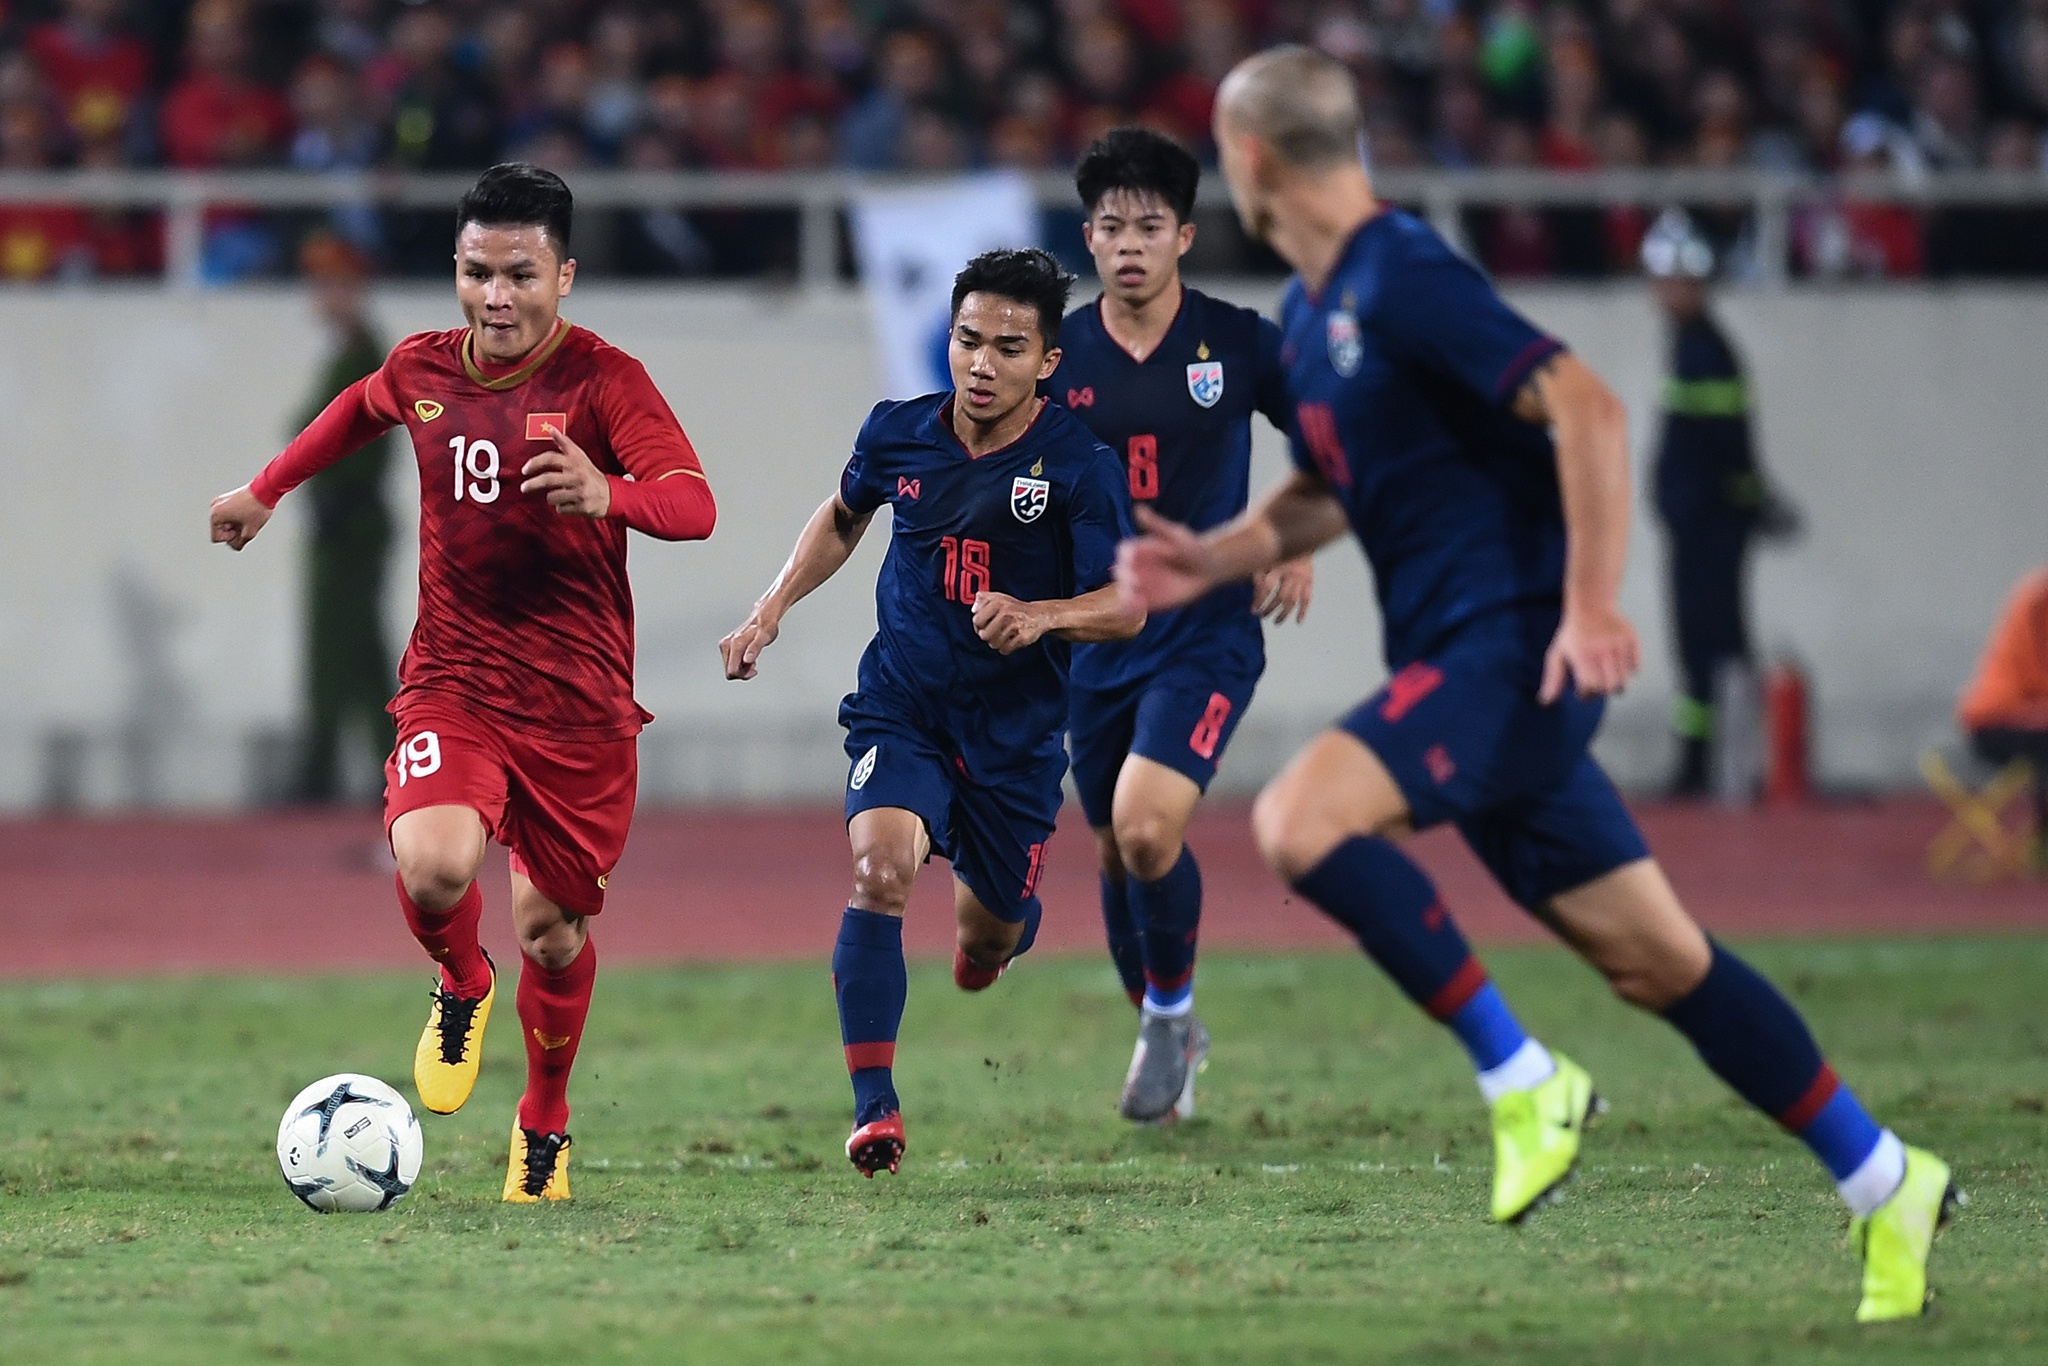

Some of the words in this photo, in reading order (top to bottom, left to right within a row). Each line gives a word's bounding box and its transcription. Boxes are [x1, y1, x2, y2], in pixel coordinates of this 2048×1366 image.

[448, 435, 500, 504] 19
[1127, 433, 1159, 499] 8
[940, 535, 990, 605] 18
[397, 730, 442, 788] 19
[1188, 691, 1231, 760] 8
